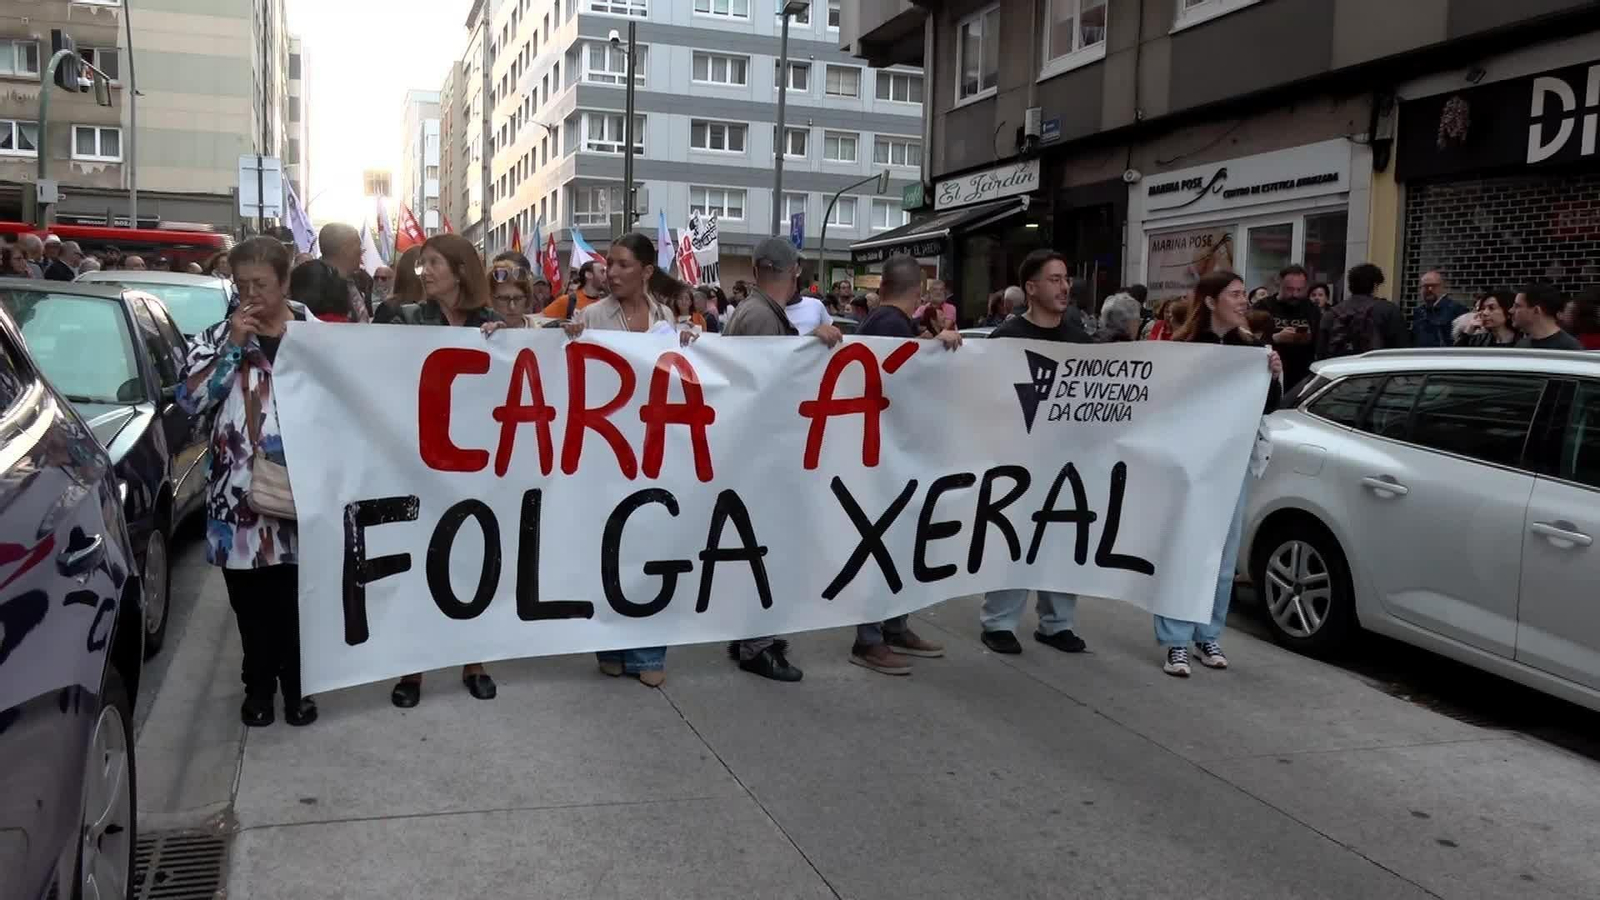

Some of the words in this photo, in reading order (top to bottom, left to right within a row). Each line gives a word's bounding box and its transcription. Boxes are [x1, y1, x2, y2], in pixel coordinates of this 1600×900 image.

[1148, 179, 1180, 197] MARINA
[1181, 176, 1203, 191] POSE
[1223, 186, 1250, 198] CENTRO
[1251, 184, 1261, 194] DE
[1296, 172, 1339, 187] AVANZADA
[1152, 236, 1187, 253] MARINA
[1189, 234, 1213, 249] POSE
[1061, 358, 1153, 380] SINDICATO
[1055, 380, 1080, 399] DE
[1083, 381, 1149, 402] VIVENDA
[418, 348, 716, 483] CARA
[800, 341, 920, 471] Á
[1047, 402, 1071, 422] DA
[1073, 401, 1132, 423] CORUÑA
[342, 487, 774, 647] FOLGA
[821, 460, 1156, 601] XERAL
